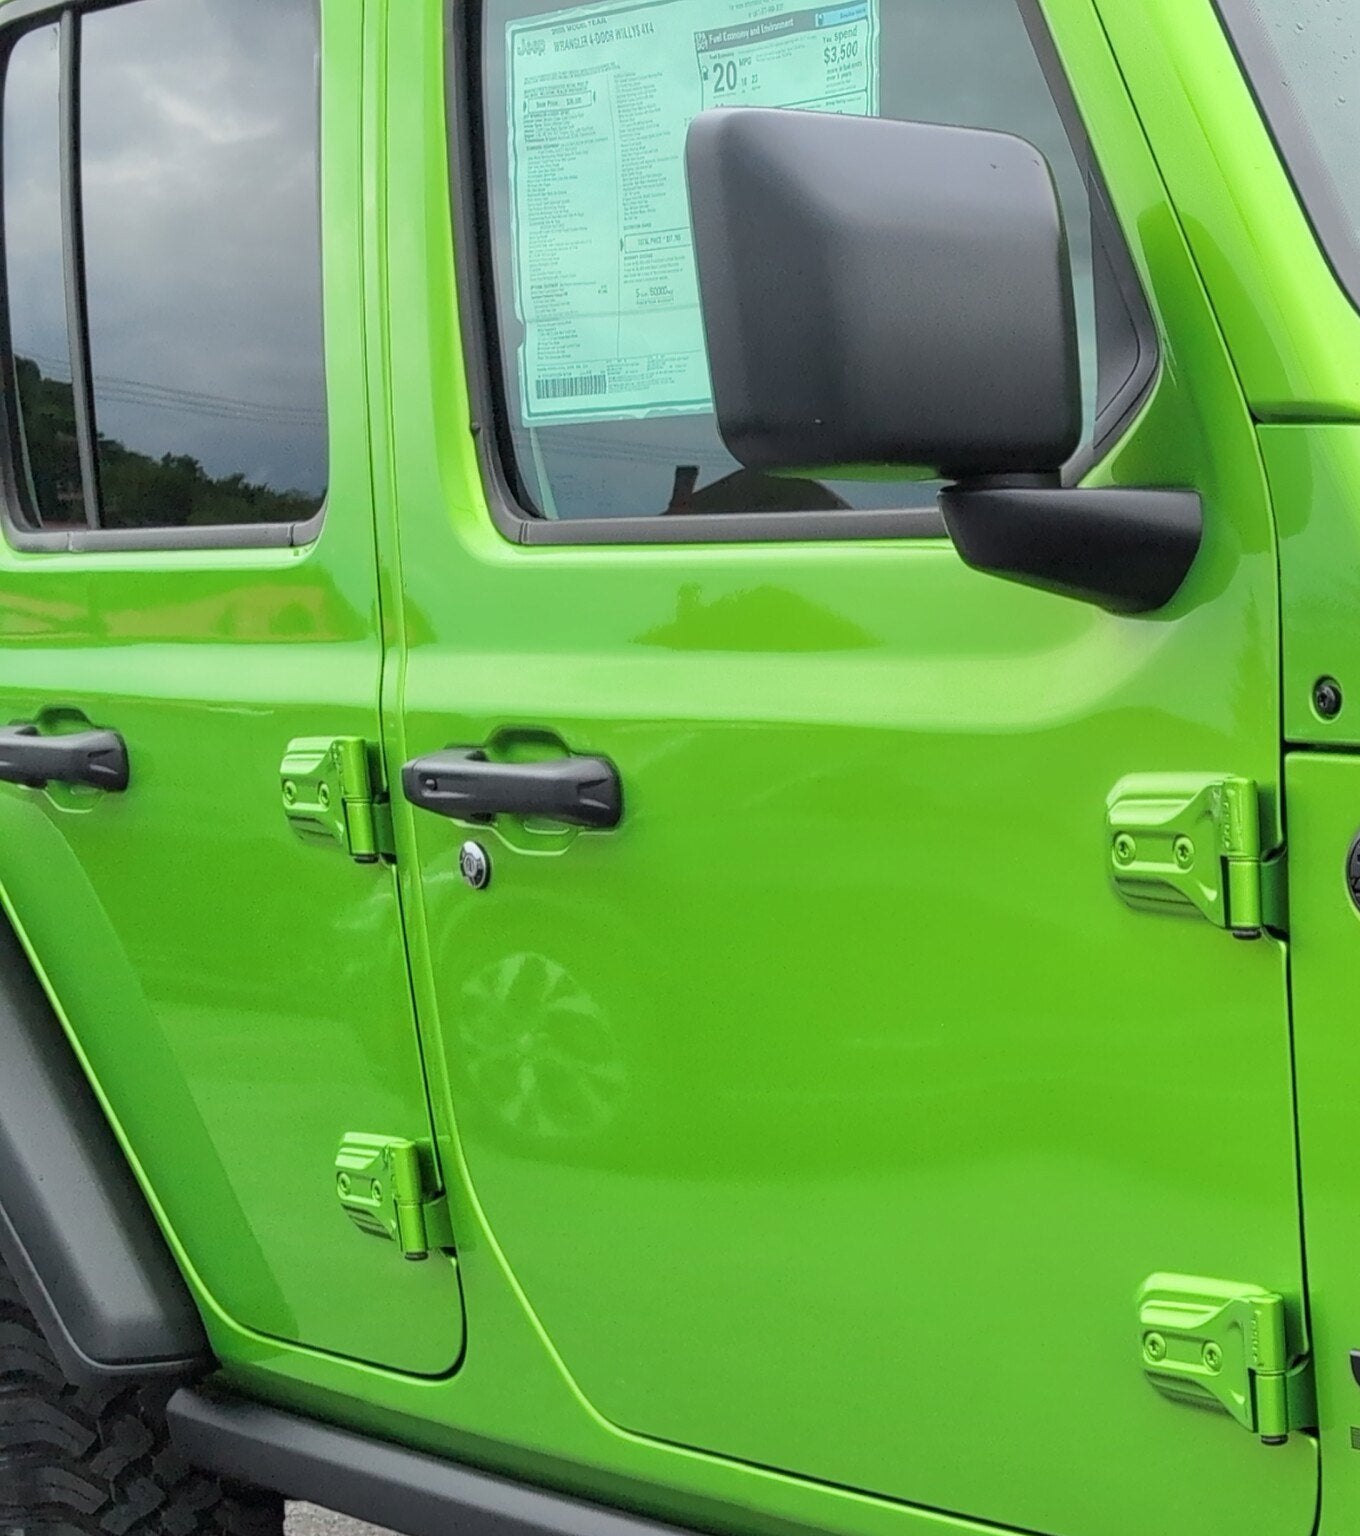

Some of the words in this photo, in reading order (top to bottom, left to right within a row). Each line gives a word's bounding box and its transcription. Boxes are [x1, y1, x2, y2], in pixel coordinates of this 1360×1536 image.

[709, 32, 723, 44] Fuel
[834, 25, 858, 43] spend
[517, 38, 546, 56] Jeep
[823, 40, 859, 66] $3,500
[713, 60, 738, 94] 20
